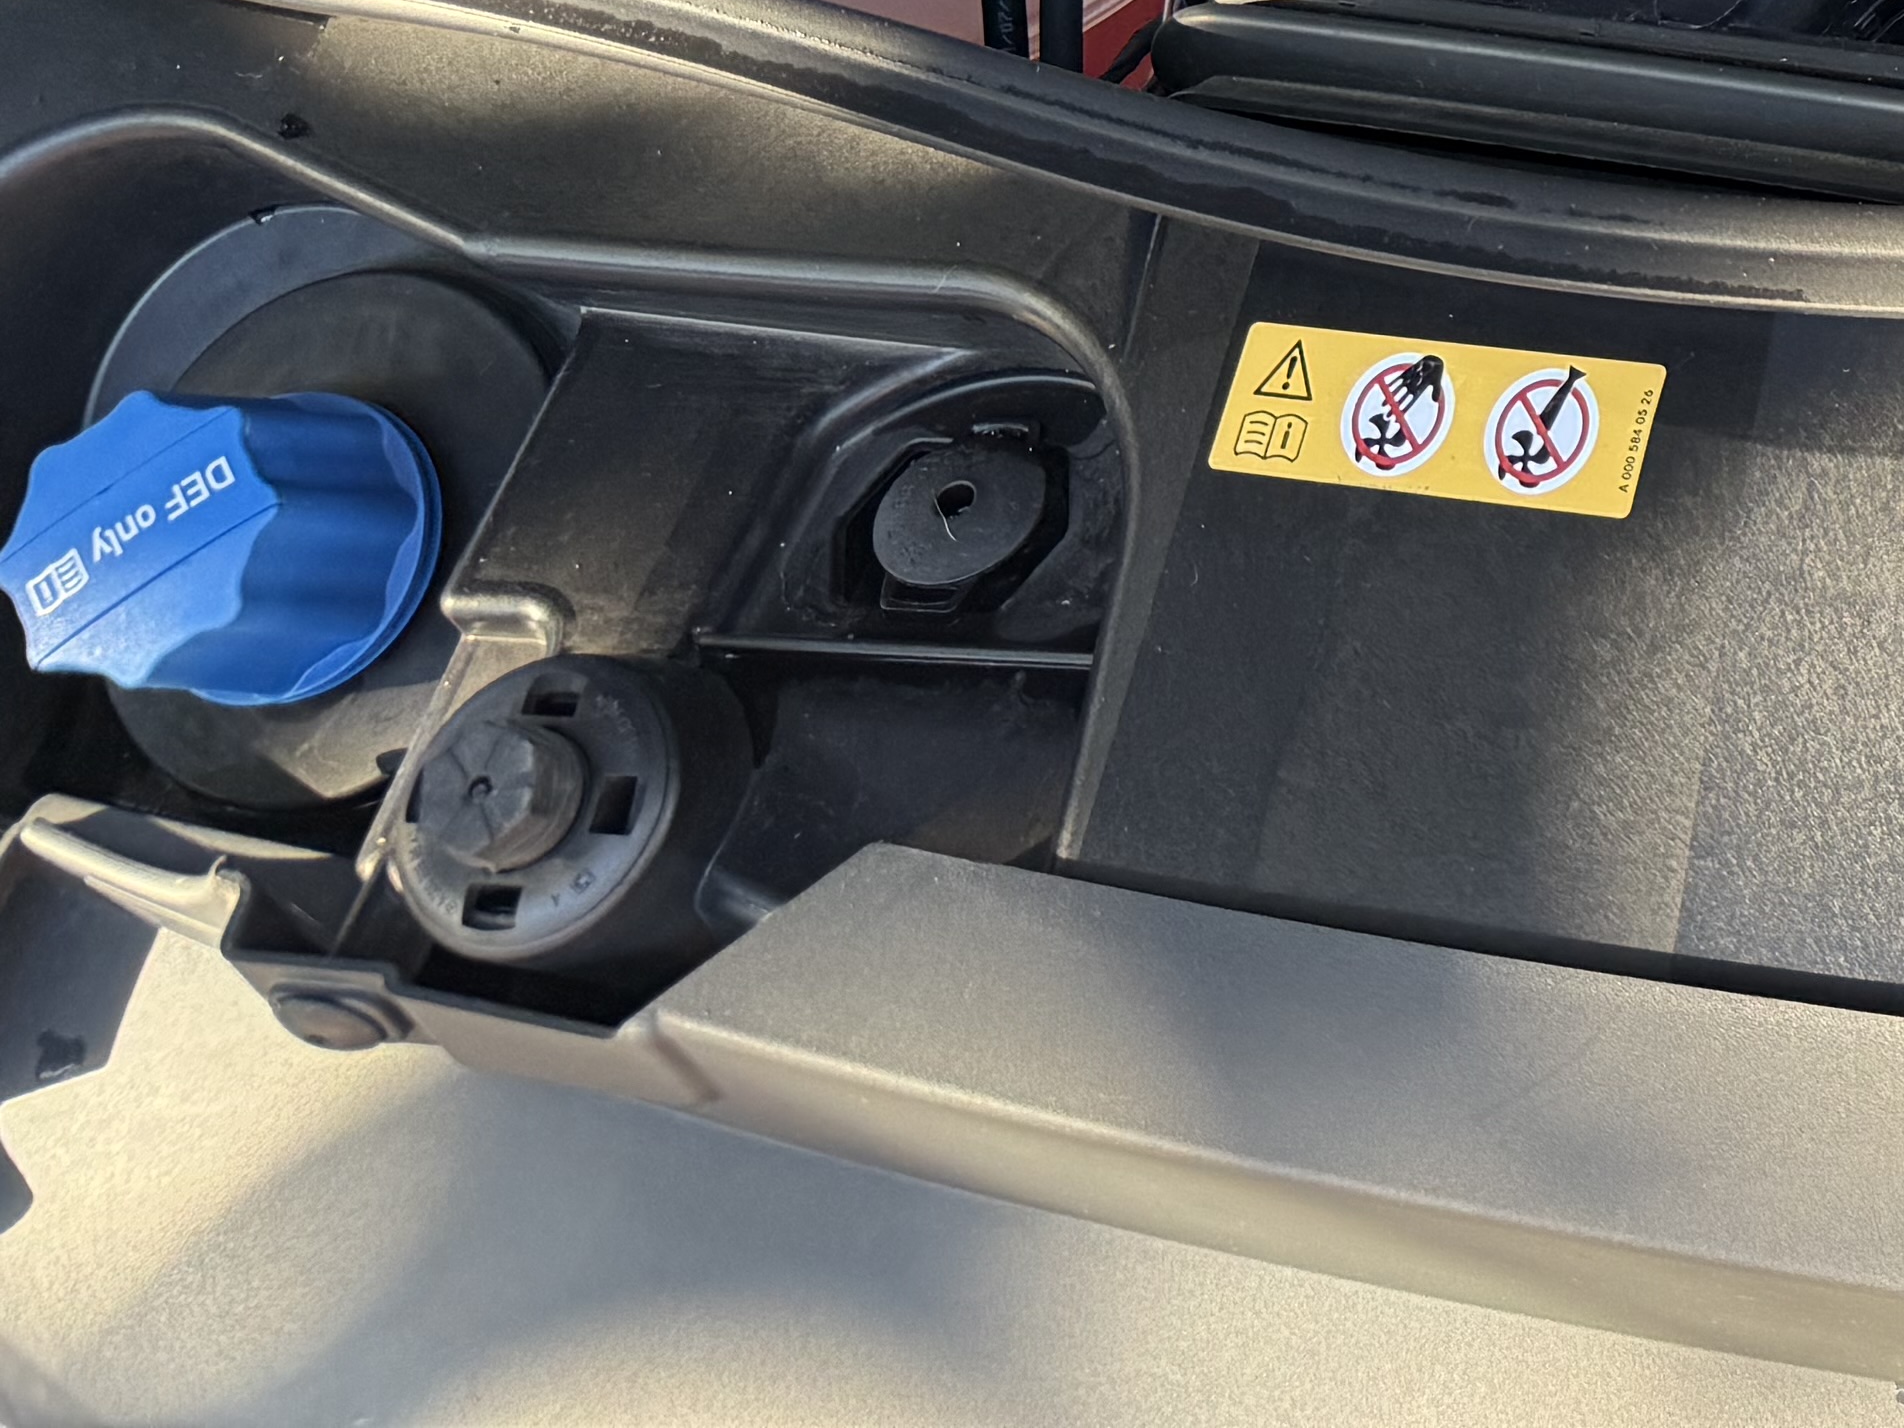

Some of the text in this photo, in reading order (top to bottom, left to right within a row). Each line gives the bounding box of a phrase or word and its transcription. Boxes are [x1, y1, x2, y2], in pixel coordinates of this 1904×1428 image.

[1618, 389, 1655, 493] A 000 584 05 26
[92, 455, 236, 563] DEF only
